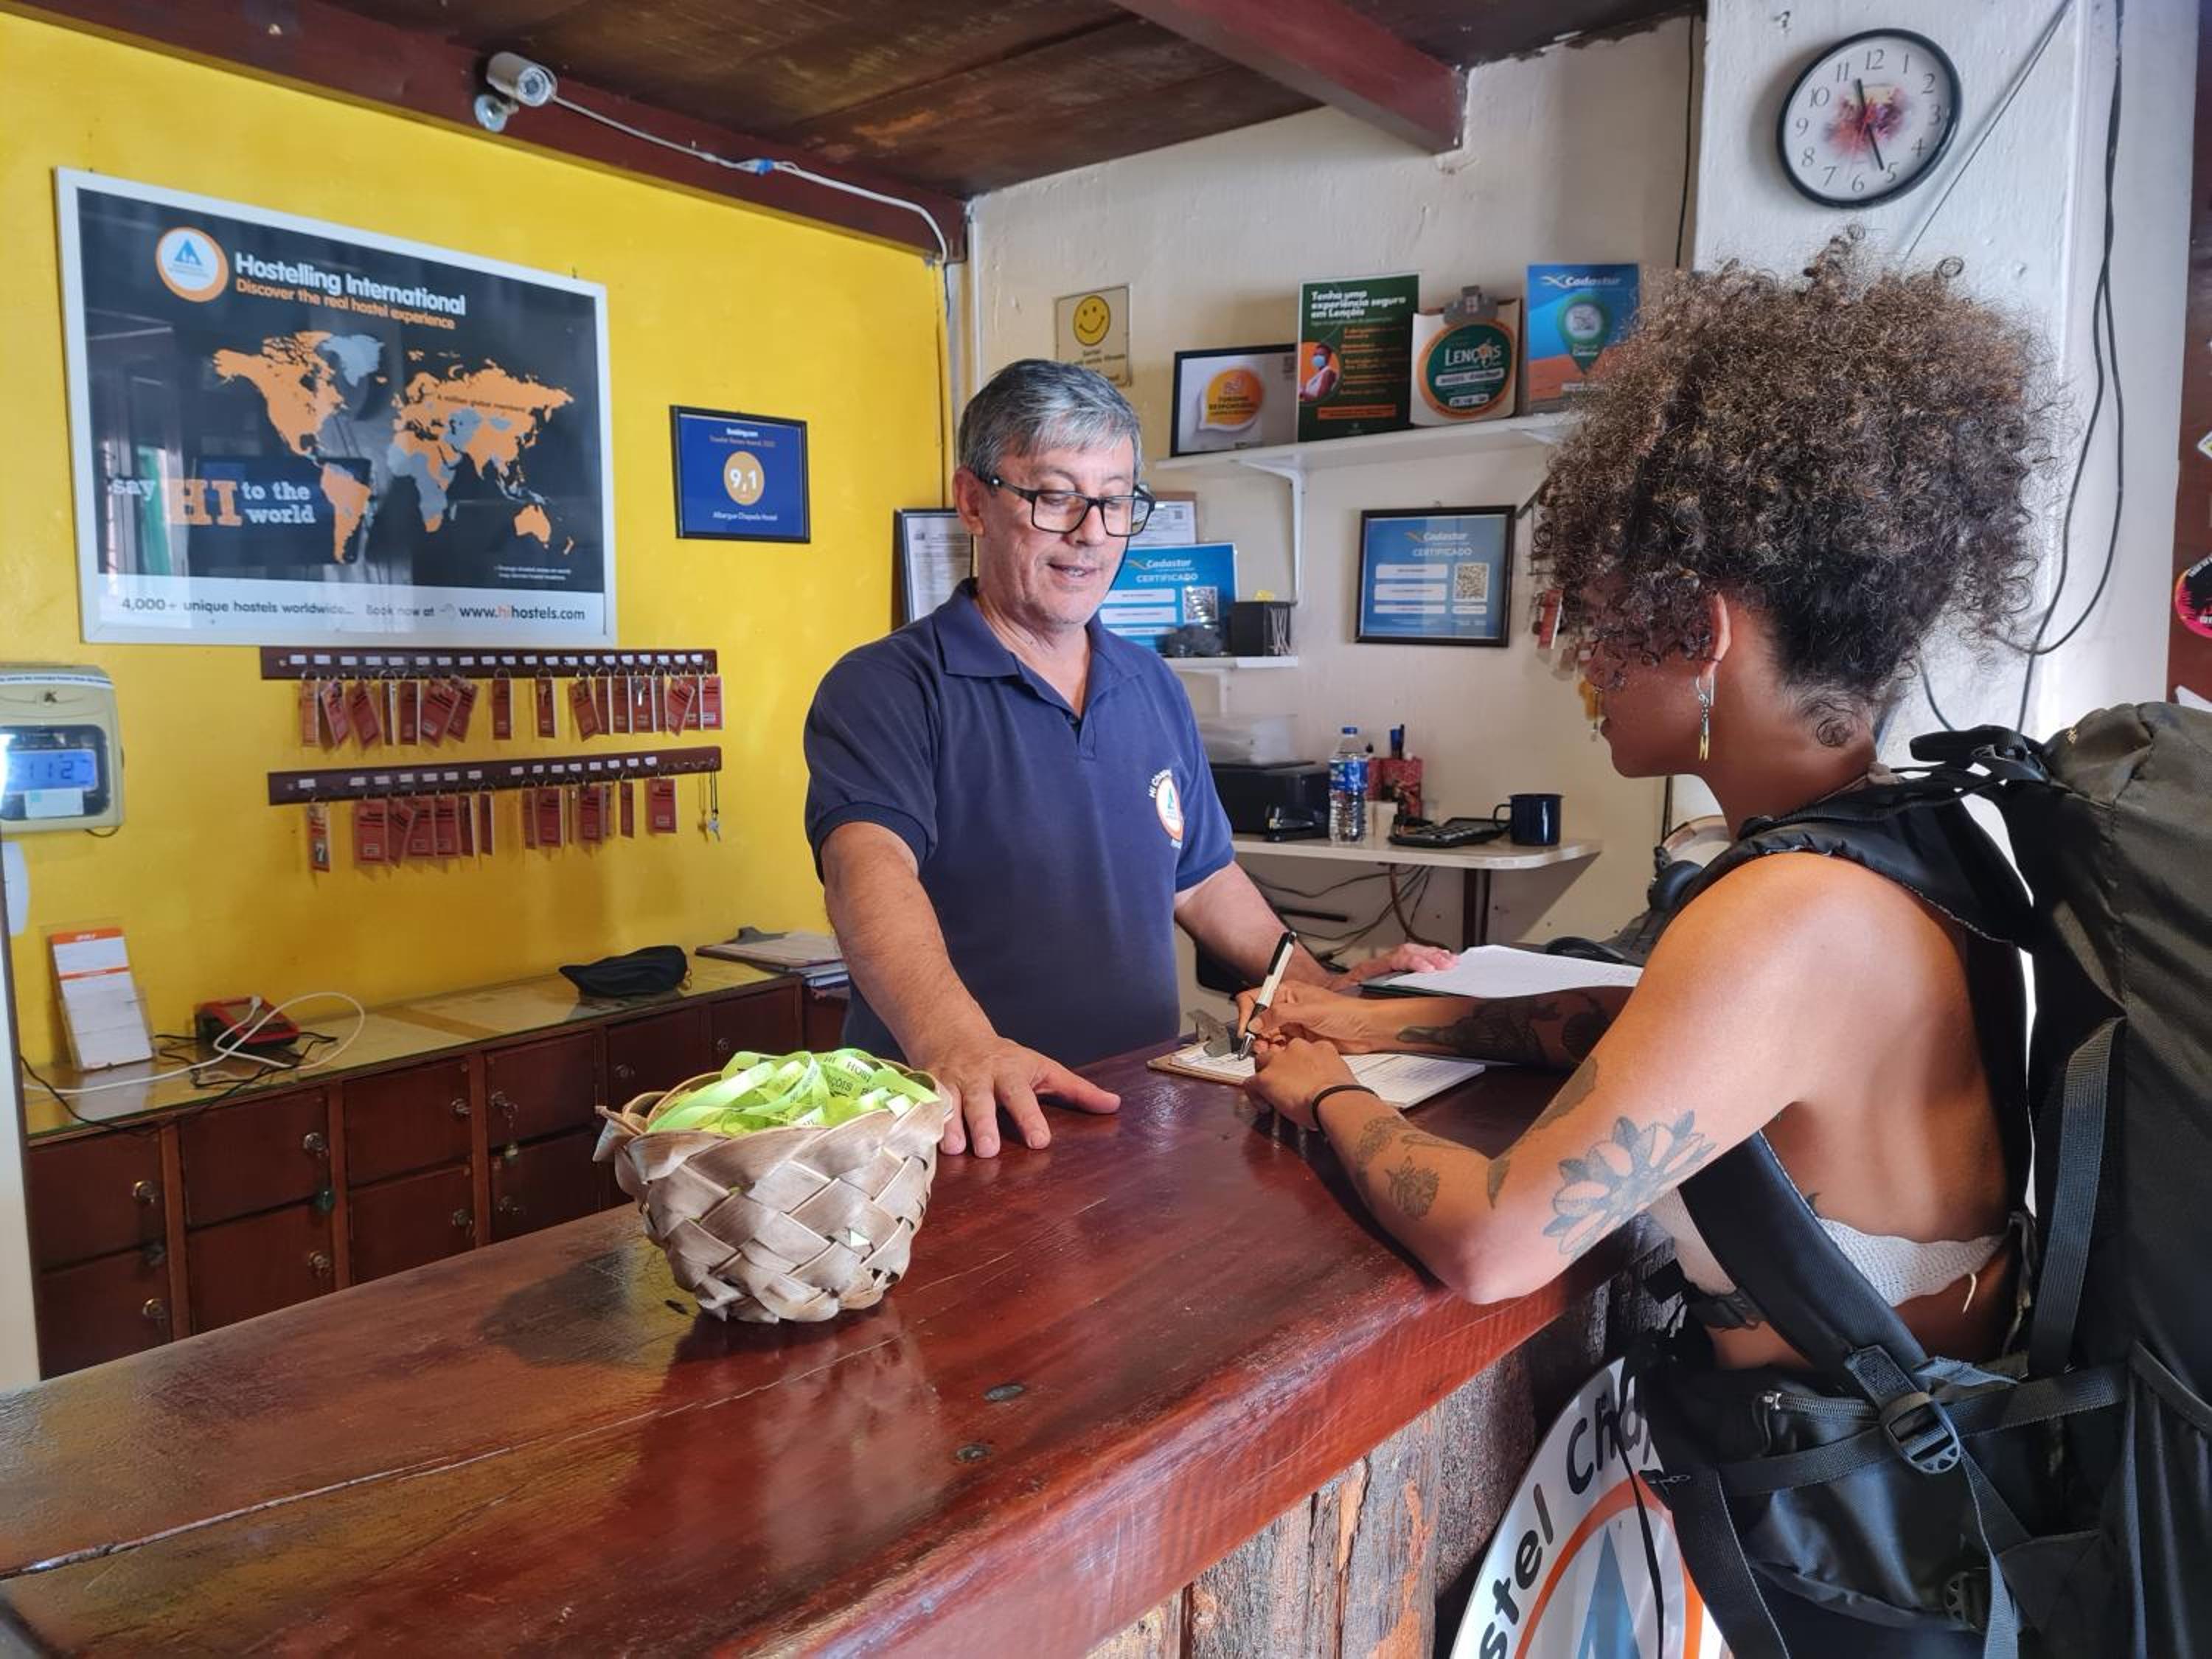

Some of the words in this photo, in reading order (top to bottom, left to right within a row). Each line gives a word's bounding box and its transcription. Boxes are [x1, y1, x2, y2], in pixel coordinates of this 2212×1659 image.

[1865, 49, 1885, 71] 12
[1903, 52, 1910, 74] 1
[1836, 62, 1850, 83] 11
[1921, 73, 1935, 94] 2
[1809, 86, 1830, 108] 10
[1929, 105, 1941, 126] 3
[1795, 117, 1809, 137] 9
[1801, 147, 1816, 167] 8
[1911, 137, 1924, 158] 4
[1823, 165, 1839, 187] 7
[1887, 161, 1899, 184] 5
[1851, 174, 1865, 193] 6
[234, 251, 342, 296] Hostelling
[347, 273, 466, 316] International
[236, 279, 294, 301] Discover
[299, 289, 320, 305] the
[324, 295, 348, 310] real
[352, 298, 389, 317] hostel
[391, 309, 456, 330] experience
[1311, 290, 1342, 301] Tenha
[1371, 296, 1406, 308] segura
[729, 467, 758, 492] 9,1
[111, 479, 156, 501] say
[167, 479, 243, 526] HI
[241, 481, 265, 501] to
[272, 481, 311, 501] the
[245, 504, 317, 524] world
[1412, 548, 1473, 557] CERTIFICADO
[1146, 559, 1192, 568] Cadastur
[1135, 573, 1198, 583] CERTIFICADO
[184, 601, 229, 614] unique
[233, 601, 278, 613] hostels
[423, 607, 434, 616] at
[459, 605, 585, 620] www.hihostels.com
